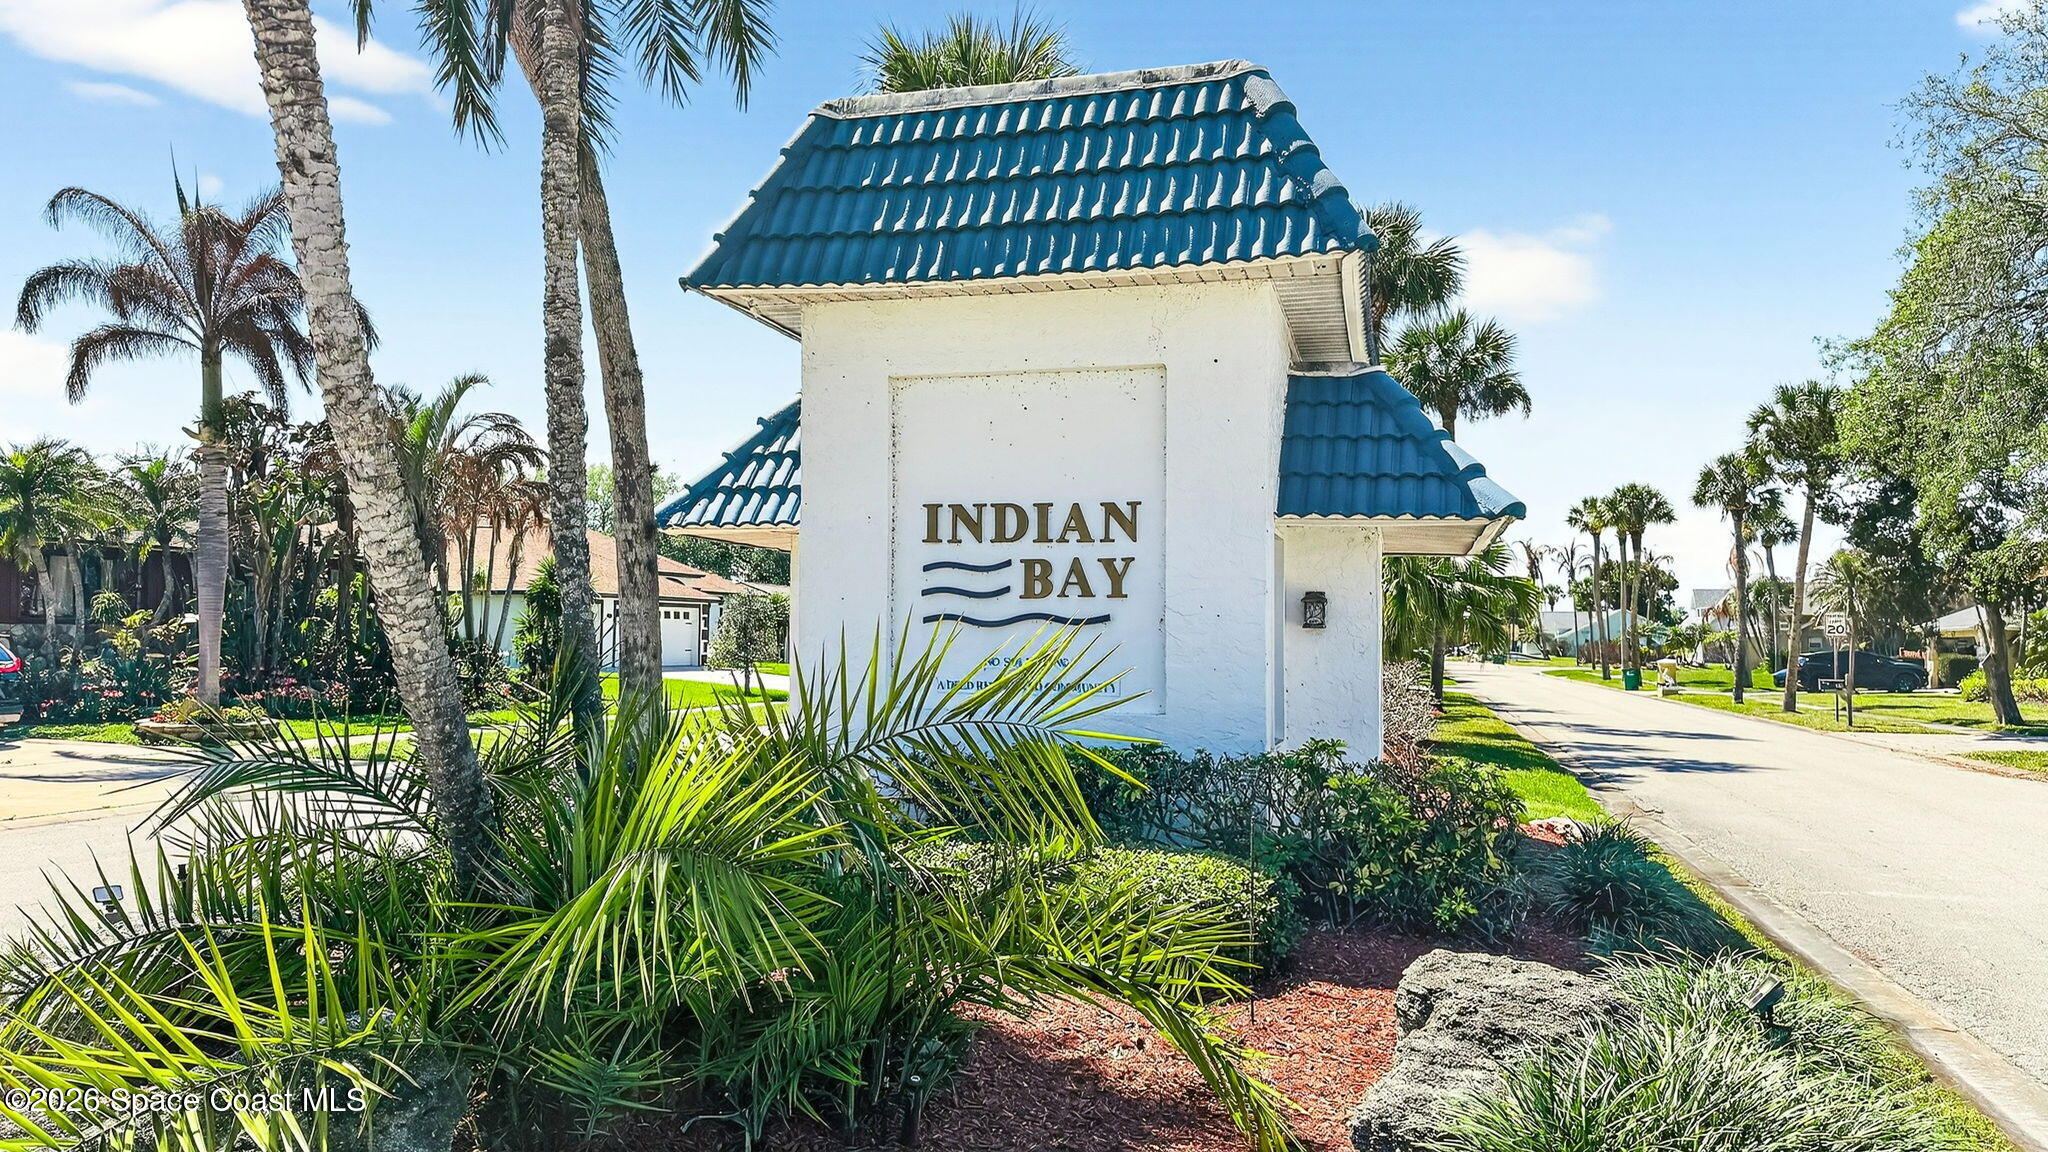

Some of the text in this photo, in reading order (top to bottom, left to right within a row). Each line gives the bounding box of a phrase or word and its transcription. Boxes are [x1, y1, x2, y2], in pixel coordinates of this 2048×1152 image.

[922, 501, 1142, 543] INDIAN
[1019, 557, 1135, 599] BAY
[1827, 624, 1845, 634] 20
